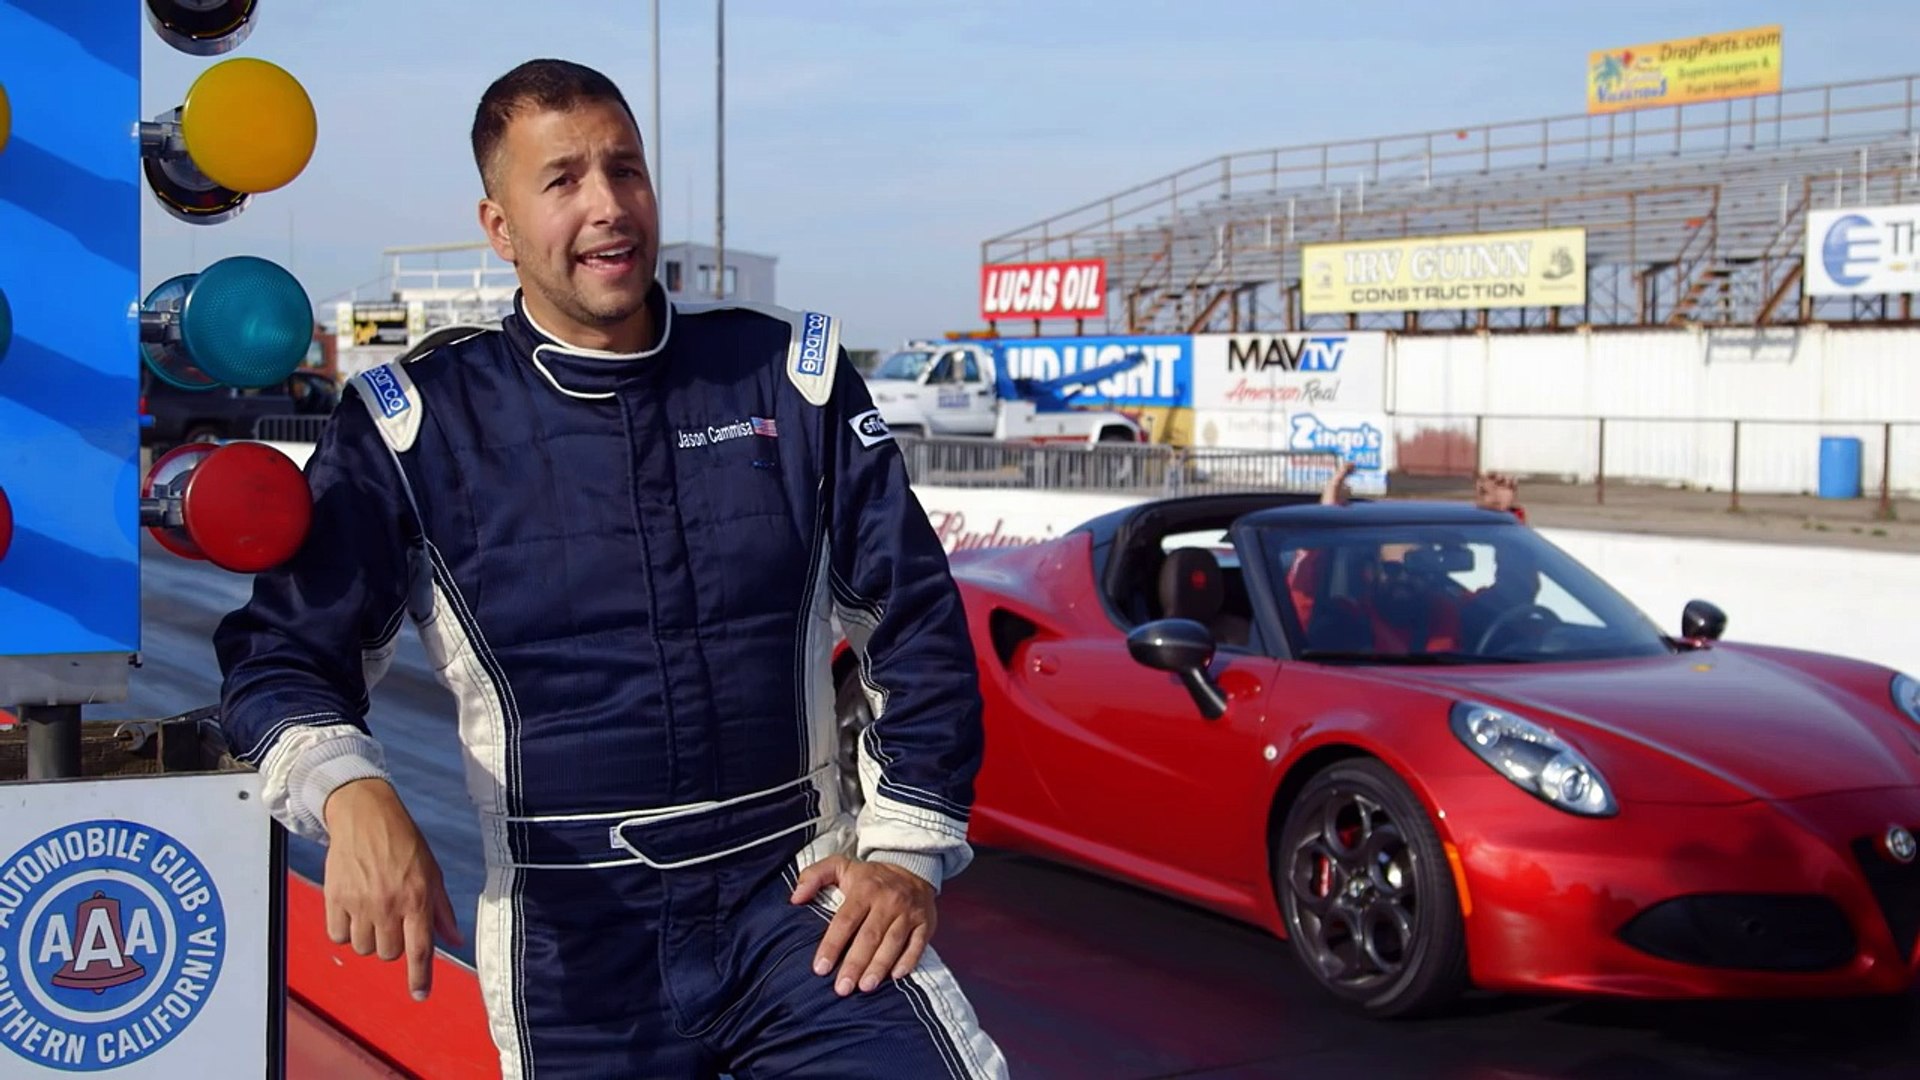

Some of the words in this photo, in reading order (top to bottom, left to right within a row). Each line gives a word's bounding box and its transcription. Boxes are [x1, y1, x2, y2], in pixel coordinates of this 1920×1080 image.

[1659, 32, 1781, 63] DragParts.com
[1344, 248, 1403, 285] IRV
[1409, 240, 1533, 281] GUINN
[984, 266, 1060, 313] LUCAS
[1061, 265, 1100, 311] OIL
[1350, 282, 1526, 304] CONSTRUCTION
[1228, 337, 1348, 372] MAVTV
[1224, 378, 1300, 402] American
[1302, 378, 1341, 406] Real
[678, 429, 708, 448] Jason
[707, 419, 754, 443] Cammisa
[1290, 413, 1382, 455] Zingo's
[0, 827, 150, 929] AUTOMOBILE
[150, 845, 211, 912] CLUB
[38, 907, 158, 972] AAA
[97, 926, 217, 1063] CALIFORNIA
